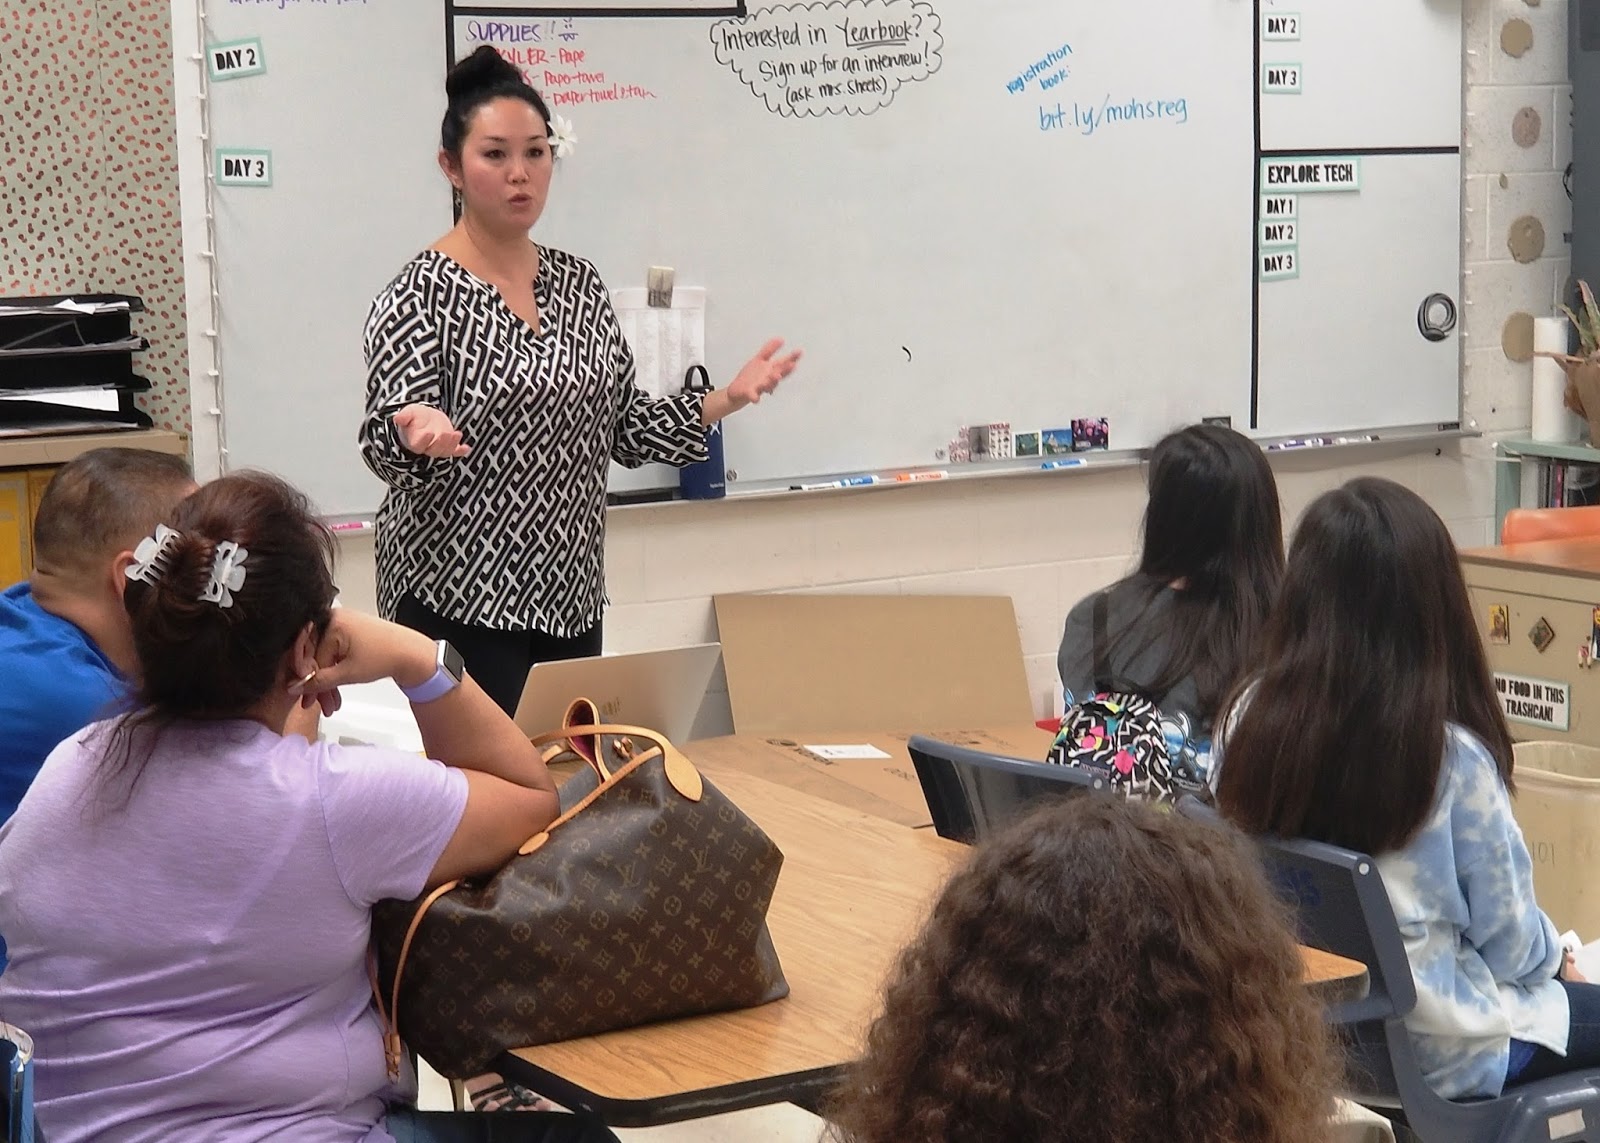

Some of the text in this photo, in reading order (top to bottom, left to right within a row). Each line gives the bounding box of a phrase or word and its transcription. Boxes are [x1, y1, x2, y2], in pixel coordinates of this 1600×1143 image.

[721, 14, 922, 50] Interested in Yearbook?
[1267, 18, 1296, 33] DAY 2
[215, 48, 256, 71] DAY 2
[759, 41, 930, 88] Sign up for an interview!
[1268, 70, 1297, 86] DAY 3
[786, 86, 813, 108] (ask
[1039, 93, 1188, 135] bit.ly/mohsreg
[224, 159, 265, 178] DAY 3
[1268, 163, 1353, 183] EXPLORE TECH
[1266, 200, 1293, 214] DAY 1
[1265, 225, 1294, 240] DAY 2
[1264, 255, 1293, 272] DAY 3
[1494, 677, 1565, 704] NO FOOD IN THIS
[1505, 698, 1553, 722] TRASHCAN!
